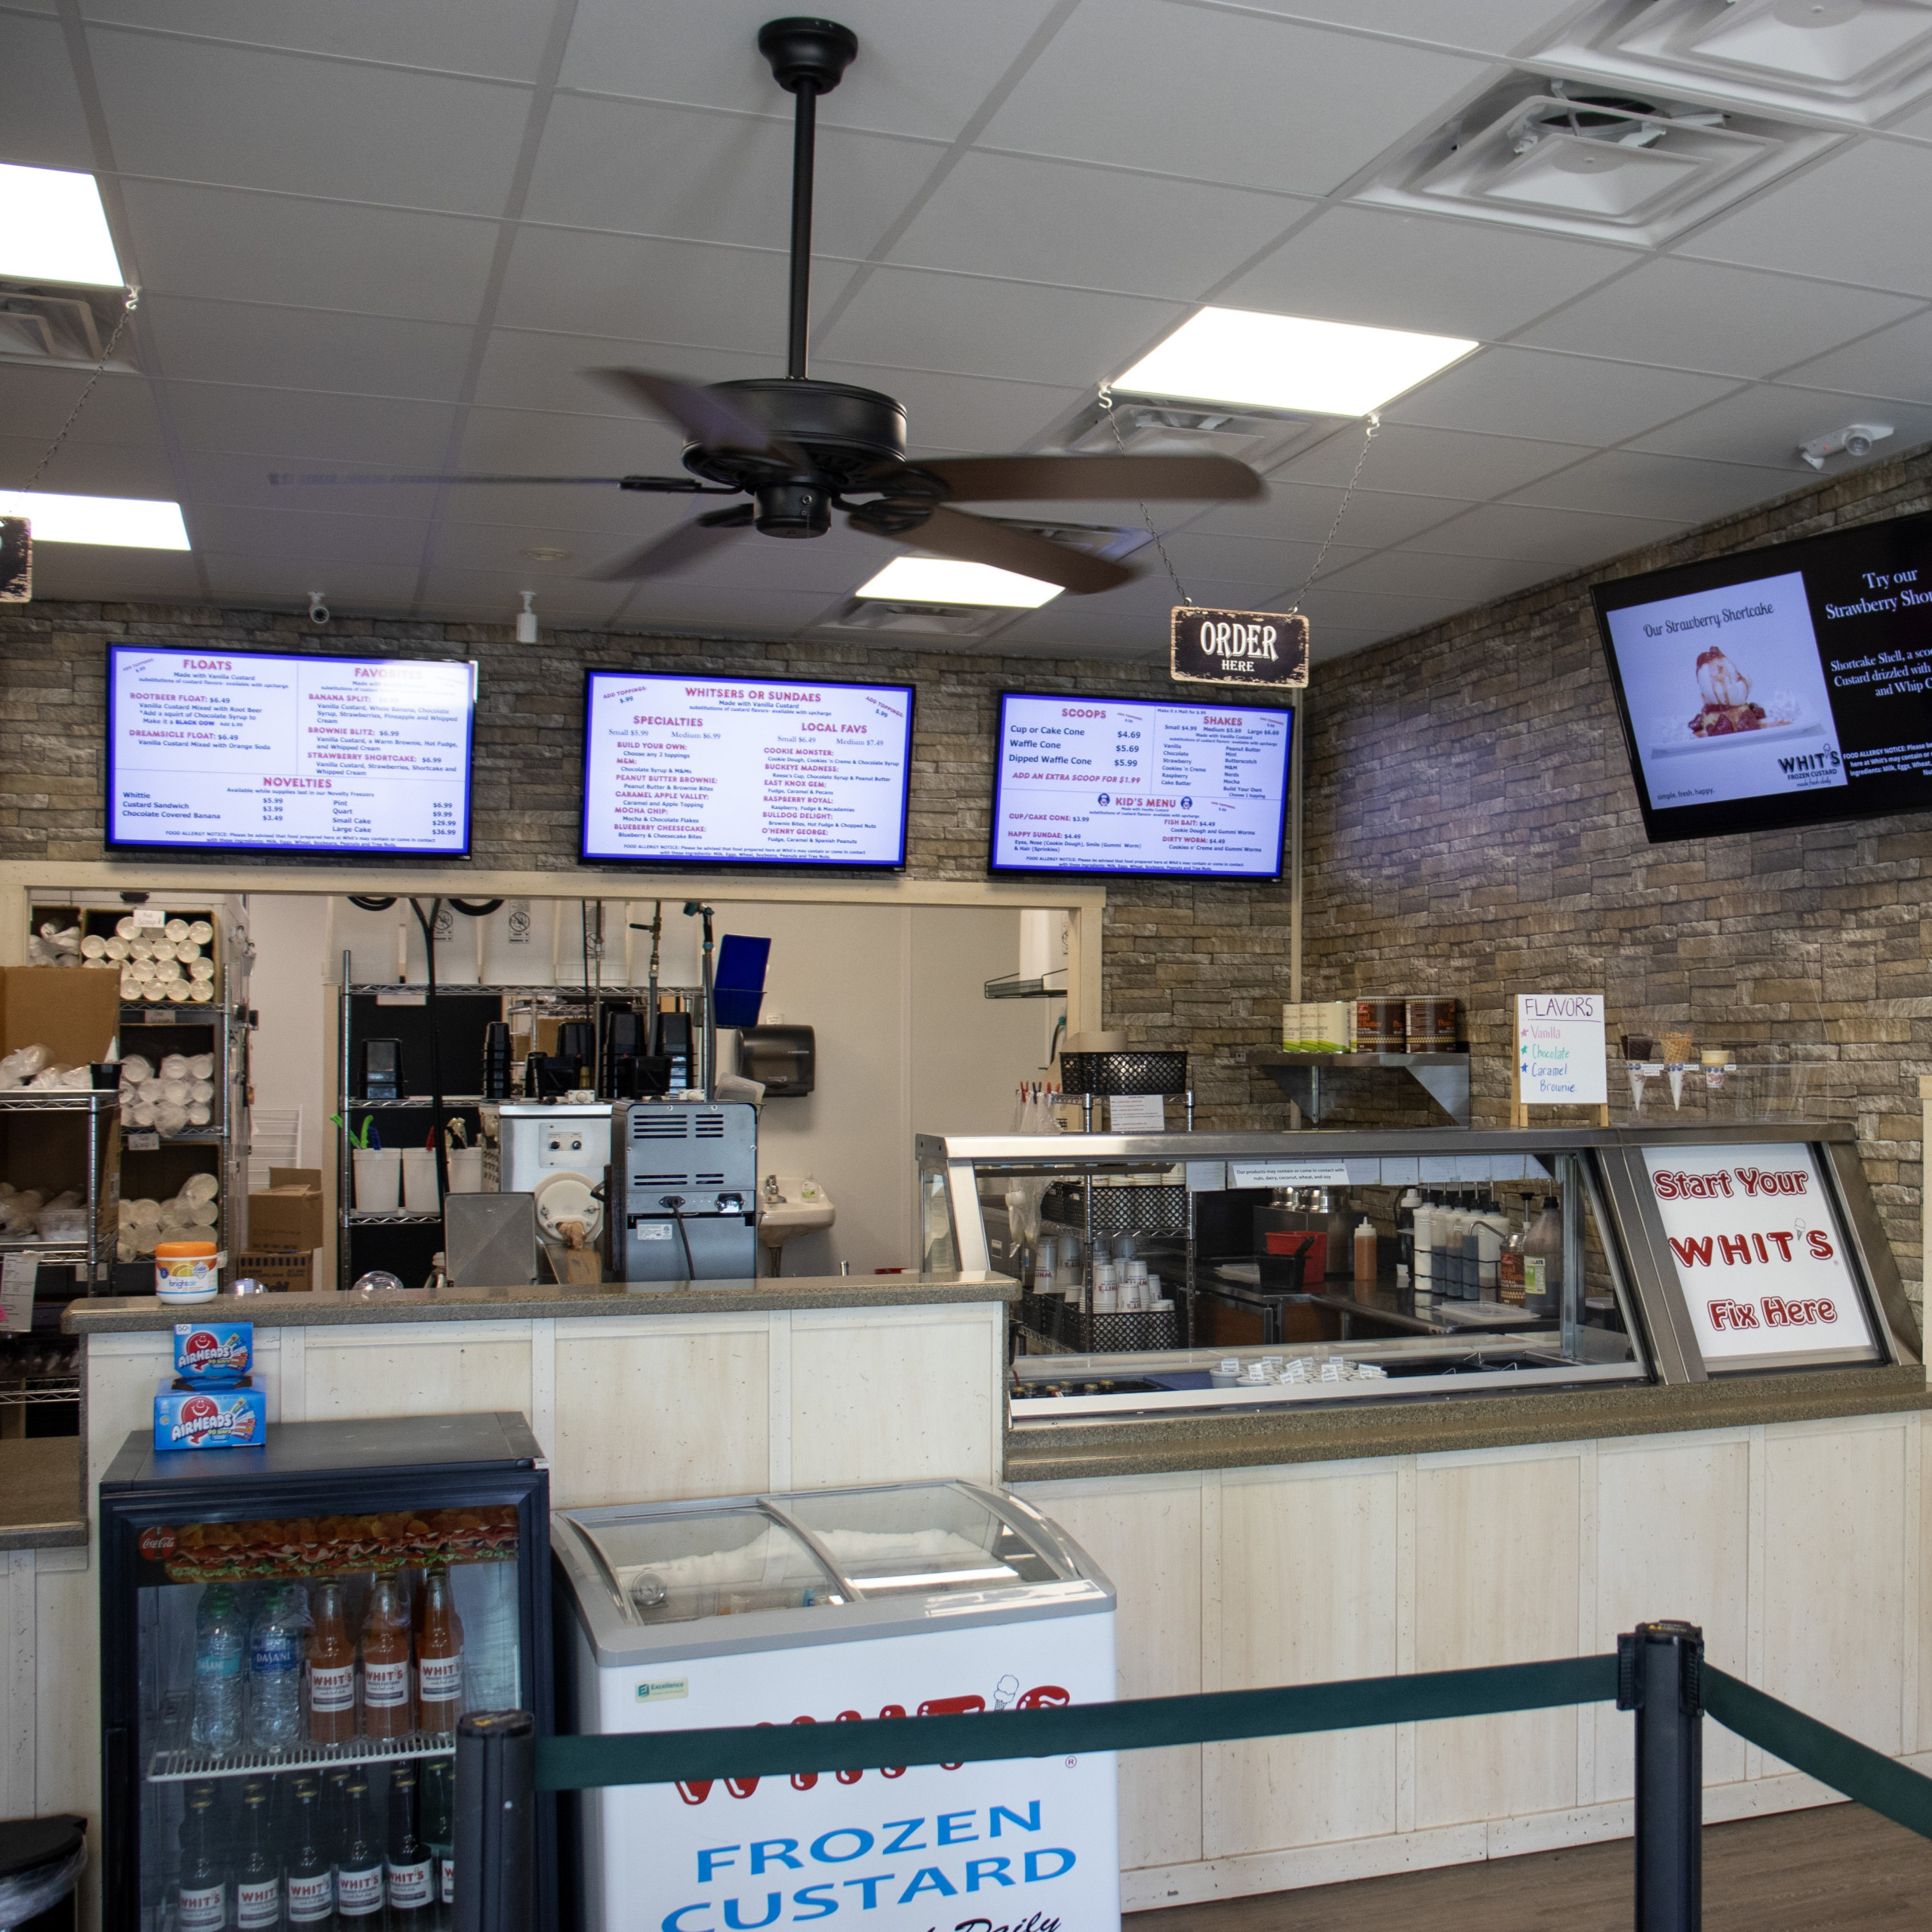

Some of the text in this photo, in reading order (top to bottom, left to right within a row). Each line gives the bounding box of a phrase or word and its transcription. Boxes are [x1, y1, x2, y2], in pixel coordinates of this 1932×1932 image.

[1863, 570, 1918, 589] Try our
[1826, 598, 1897, 619] Strawberry
[1644, 602, 1774, 637] Our Strawberry Shortcake
[1201, 621, 1278, 662] ORDER
[183, 660, 232, 671] FLOATS
[1222, 660, 1255, 672] HERE
[1831, 656, 1875, 671] Shortcake
[1878, 650, 1905, 664] Shell,
[1834, 663, 1930, 687] Custard drizzled with
[130, 693, 176, 701] ROOTBEER
[685, 688, 821, 702] WHITSERS OR SUNDAES
[1062, 708, 1106, 718] SCOOPS
[634, 715, 703, 726] SPECIALTIES
[1203, 716, 1242, 725] SHAKES
[129, 730, 184, 738] DREAMSICLE
[187, 731, 215, 740] FLOAT:
[801, 723, 867, 734] LOCAL FAVS
[1011, 725, 1026, 734] Cup
[1118, 731, 1140, 739] $4.69
[308, 752, 362, 760] STRAWBERRY
[365, 754, 416, 762] SHORTCAKE:
[1009, 755, 1038, 764] Dipped
[1041, 755, 1069, 764] Waffle
[1778, 751, 1841, 774] WHIT'S
[263, 777, 332, 788] NOVELTIES
[1788, 771, 1810, 780] FROZEN
[1116, 798, 1176, 808] KID'S MENU
[1525, 997, 1593, 1016] FLAVORS
[1531, 1026, 1561, 1039] Vanilla
[1532, 1044, 1570, 1060] Chocolate
[1532, 1063, 1567, 1077] Caramel
[1540, 1079, 1575, 1092] Brownie
[1653, 1168, 1808, 1200] Start Your
[1668, 1230, 1833, 1267] WHIT'S
[1708, 1296, 1838, 1331] Fix Here
[178, 1346, 232, 1368] AIRHEADS
[171, 1414, 233, 1441] AIRHEADS
[257, 1652, 291, 1663] DASANI
[697, 1799, 1041, 1883] FROZEN
[662, 1847, 1076, 1932] CUSTARD
